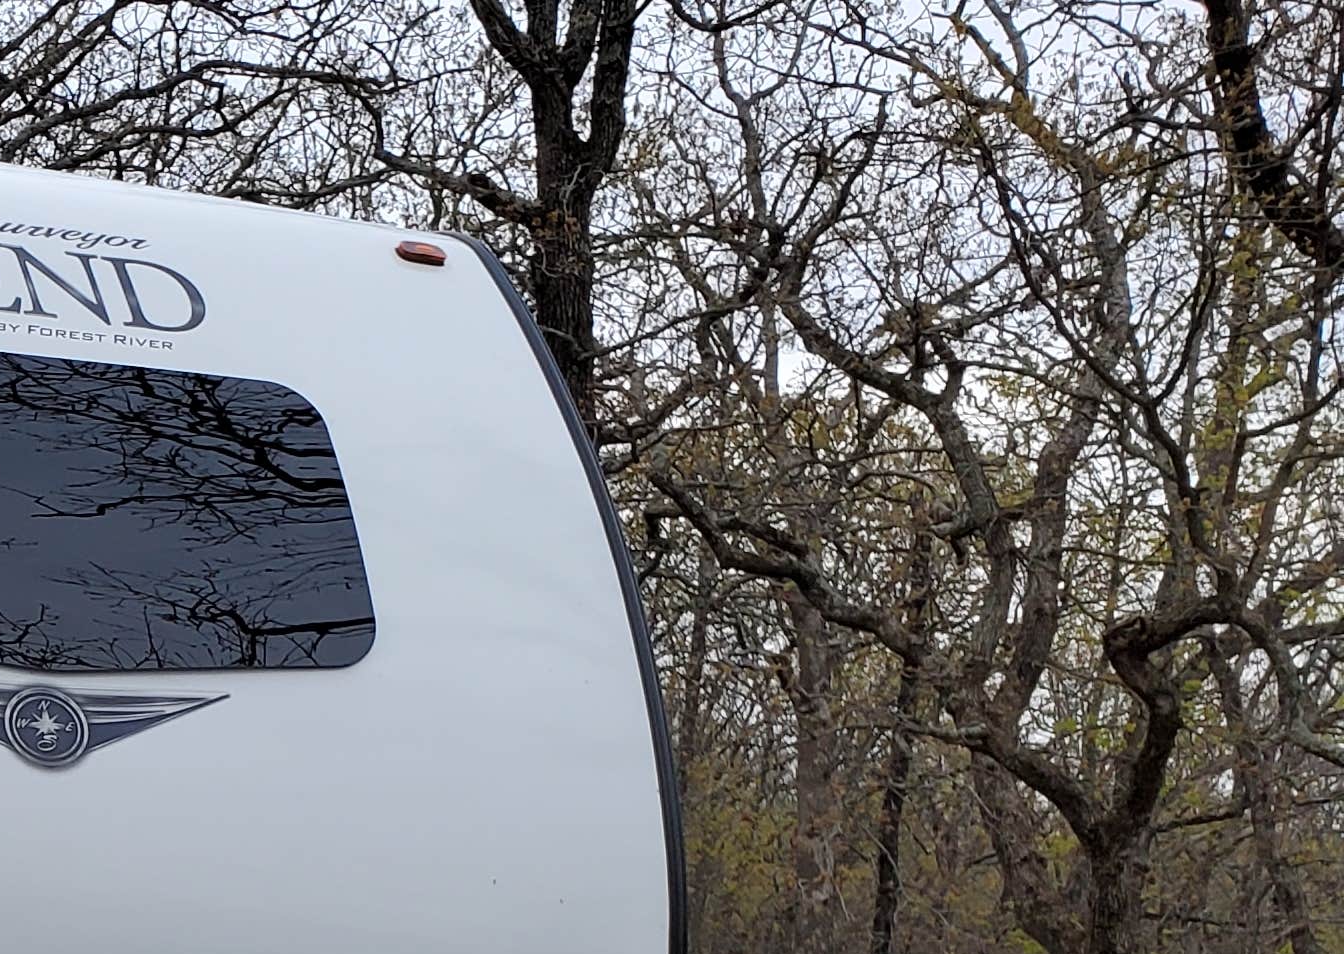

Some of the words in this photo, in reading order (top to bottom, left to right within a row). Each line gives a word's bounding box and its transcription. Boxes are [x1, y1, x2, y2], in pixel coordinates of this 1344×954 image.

[27, 324, 107, 342] FOREST
[113, 334, 173, 350] RIVER
[37, 700, 50, 711] N
[16, 718, 31, 729] W
[65, 722, 75, 731] E
[37, 734, 57, 752] S
